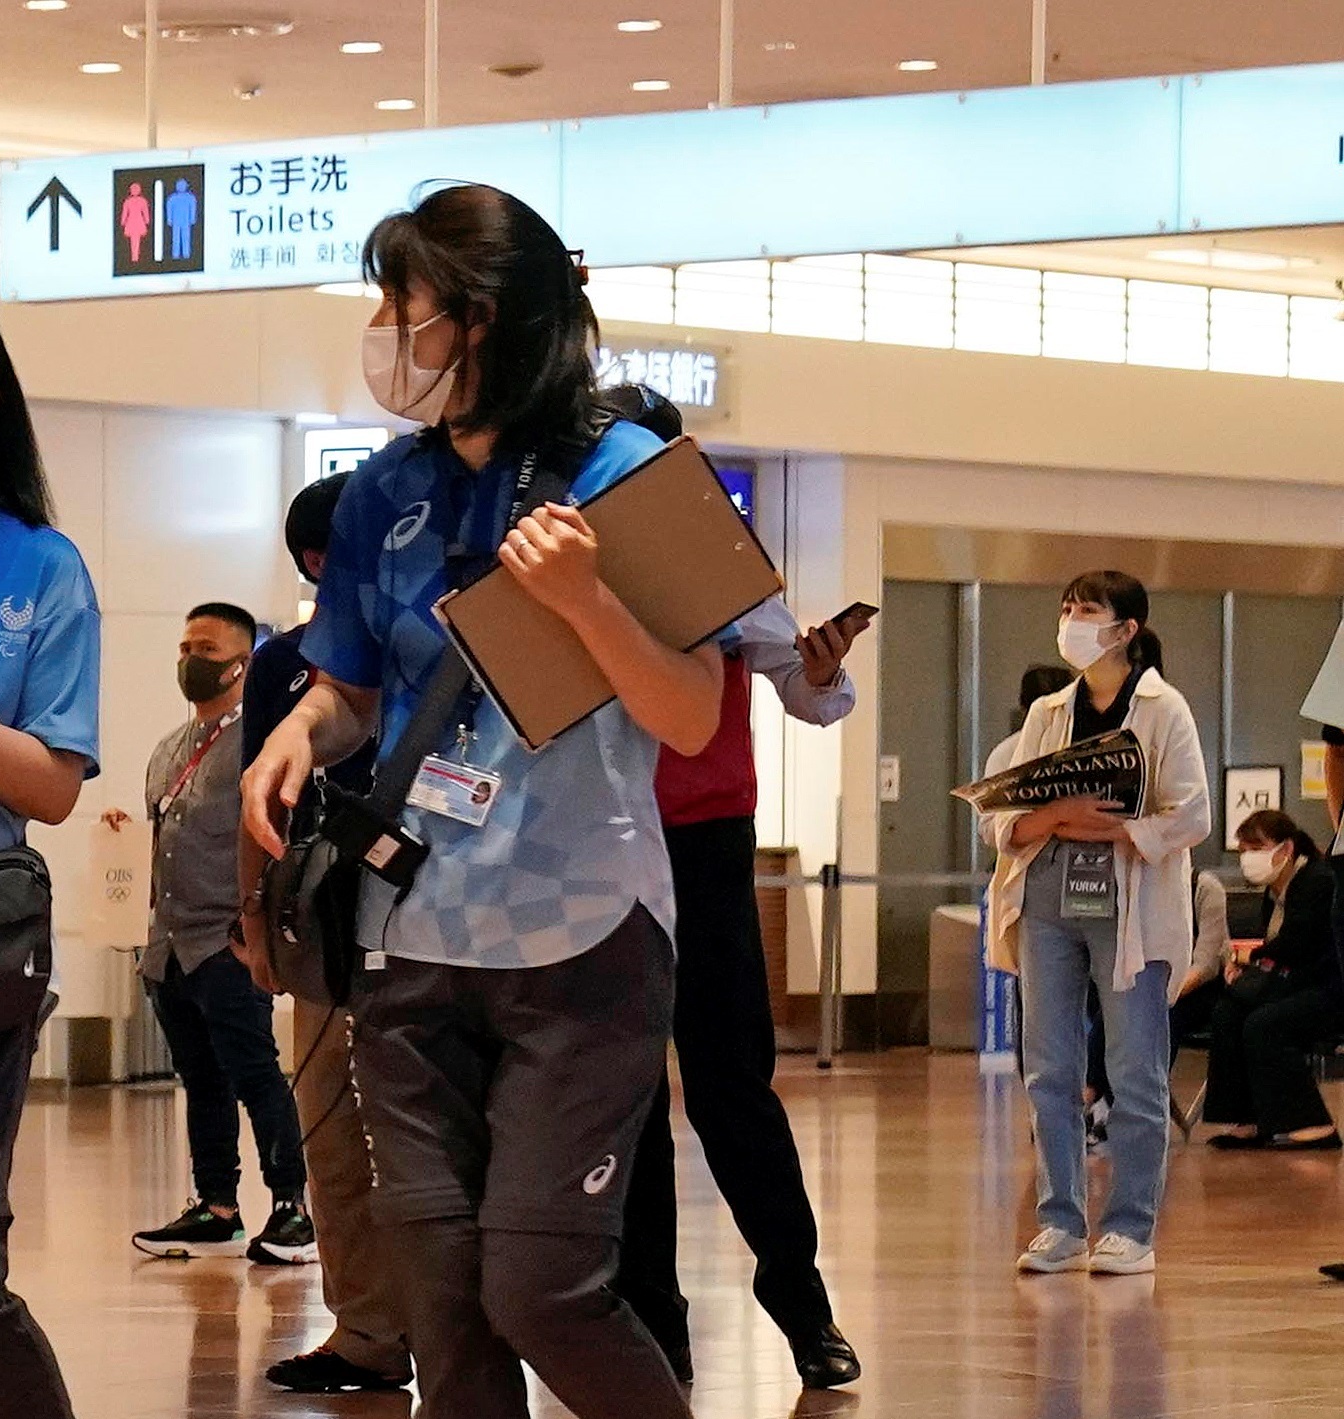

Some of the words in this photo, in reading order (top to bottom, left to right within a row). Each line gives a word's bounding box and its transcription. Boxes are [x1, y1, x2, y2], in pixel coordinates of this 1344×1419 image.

[230, 154, 348, 196] お手洗
[229, 205, 334, 236] Toilets
[313, 241, 360, 266] 화장
